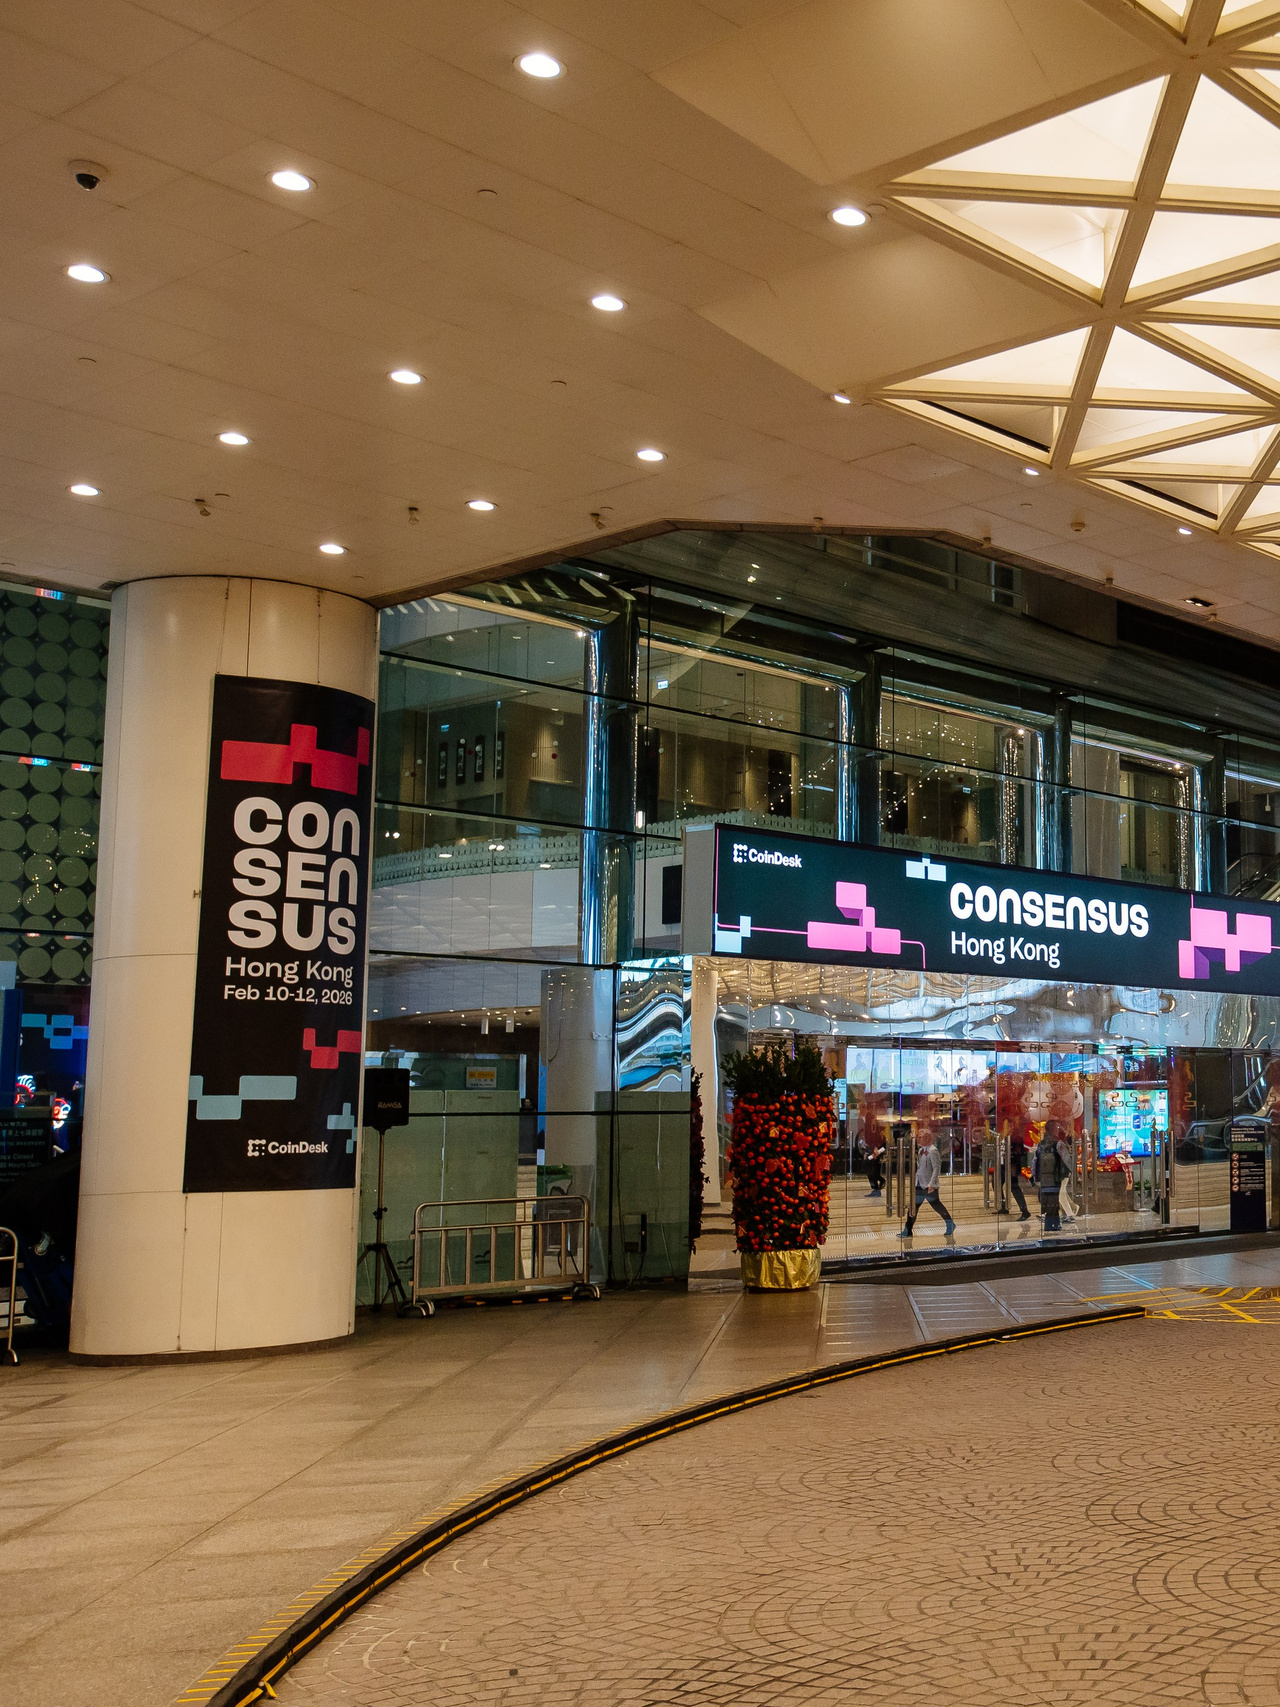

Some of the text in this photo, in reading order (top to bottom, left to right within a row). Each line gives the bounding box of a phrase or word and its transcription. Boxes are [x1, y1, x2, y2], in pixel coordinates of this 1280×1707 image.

[748, 848, 802, 868] CoinDesk
[227, 899, 357, 955] SUS
[951, 930, 1061, 969] Hong Kong
[225, 956, 354, 988] Hong Kong
[224, 984, 353, 1005] Feb 10-12, 2026
[378, 1101, 402, 1109] RAMSA
[267, 1141, 329, 1154] CoinDesk
